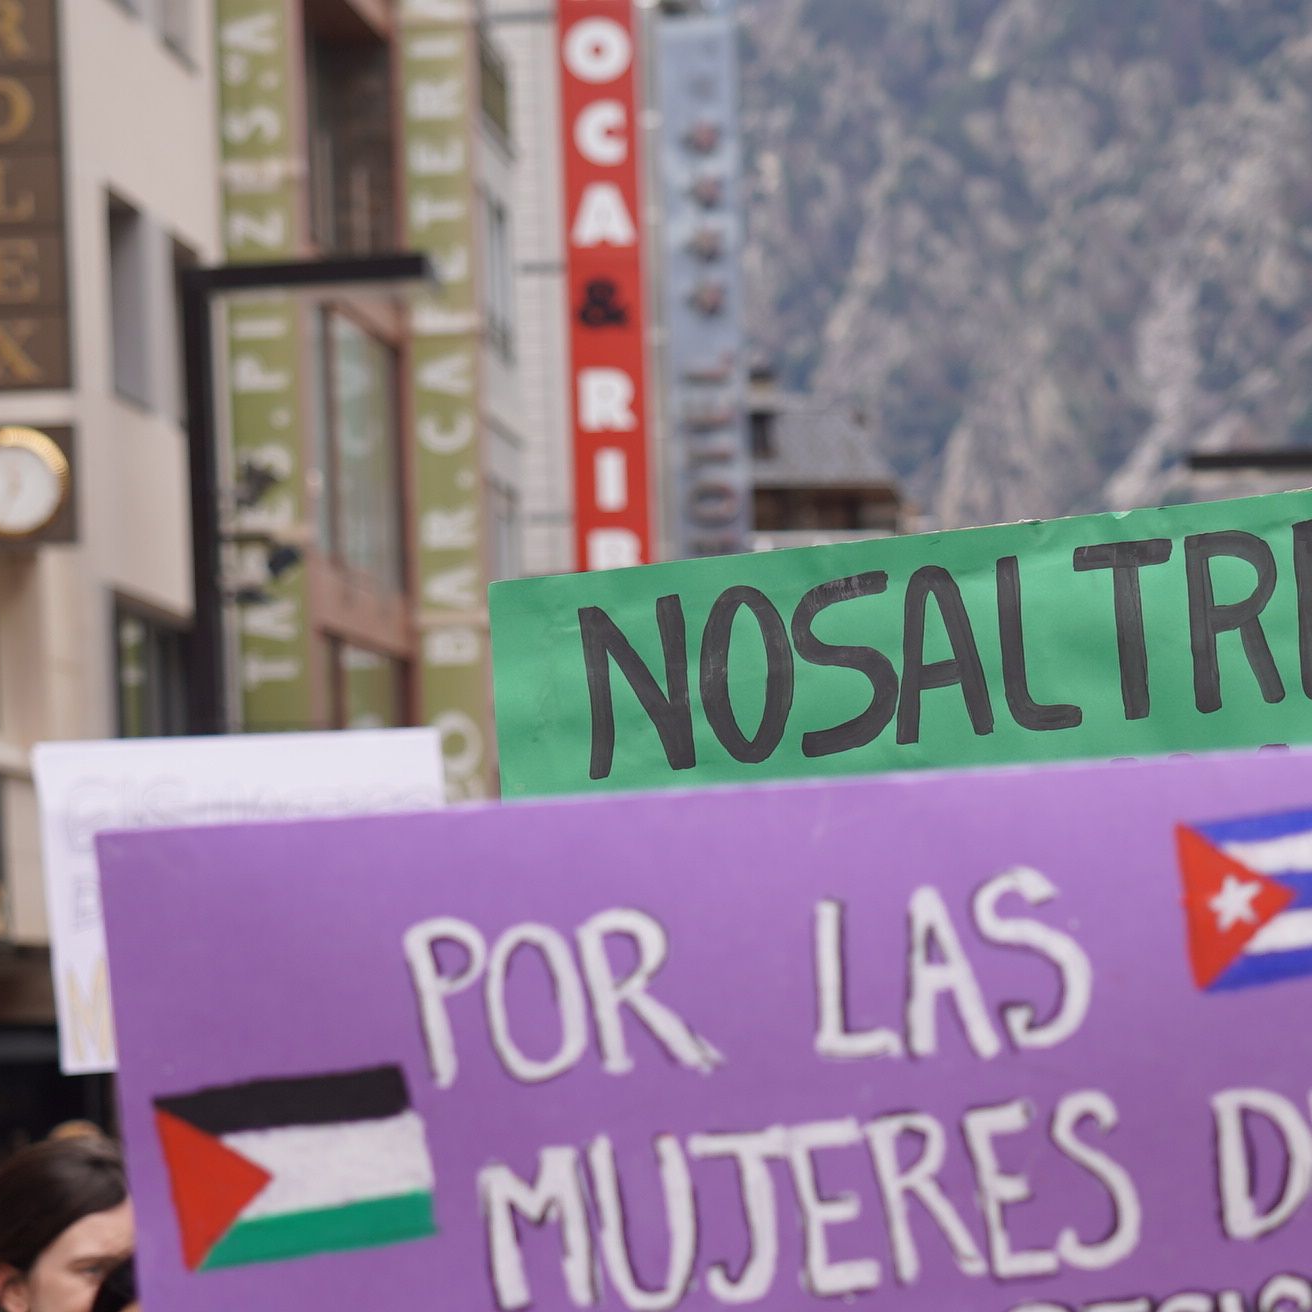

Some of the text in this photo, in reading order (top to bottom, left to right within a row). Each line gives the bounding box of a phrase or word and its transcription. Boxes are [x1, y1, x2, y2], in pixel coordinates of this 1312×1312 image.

[577, 280, 627, 330] &
[402, 866, 1094, 1088] POR LAS
